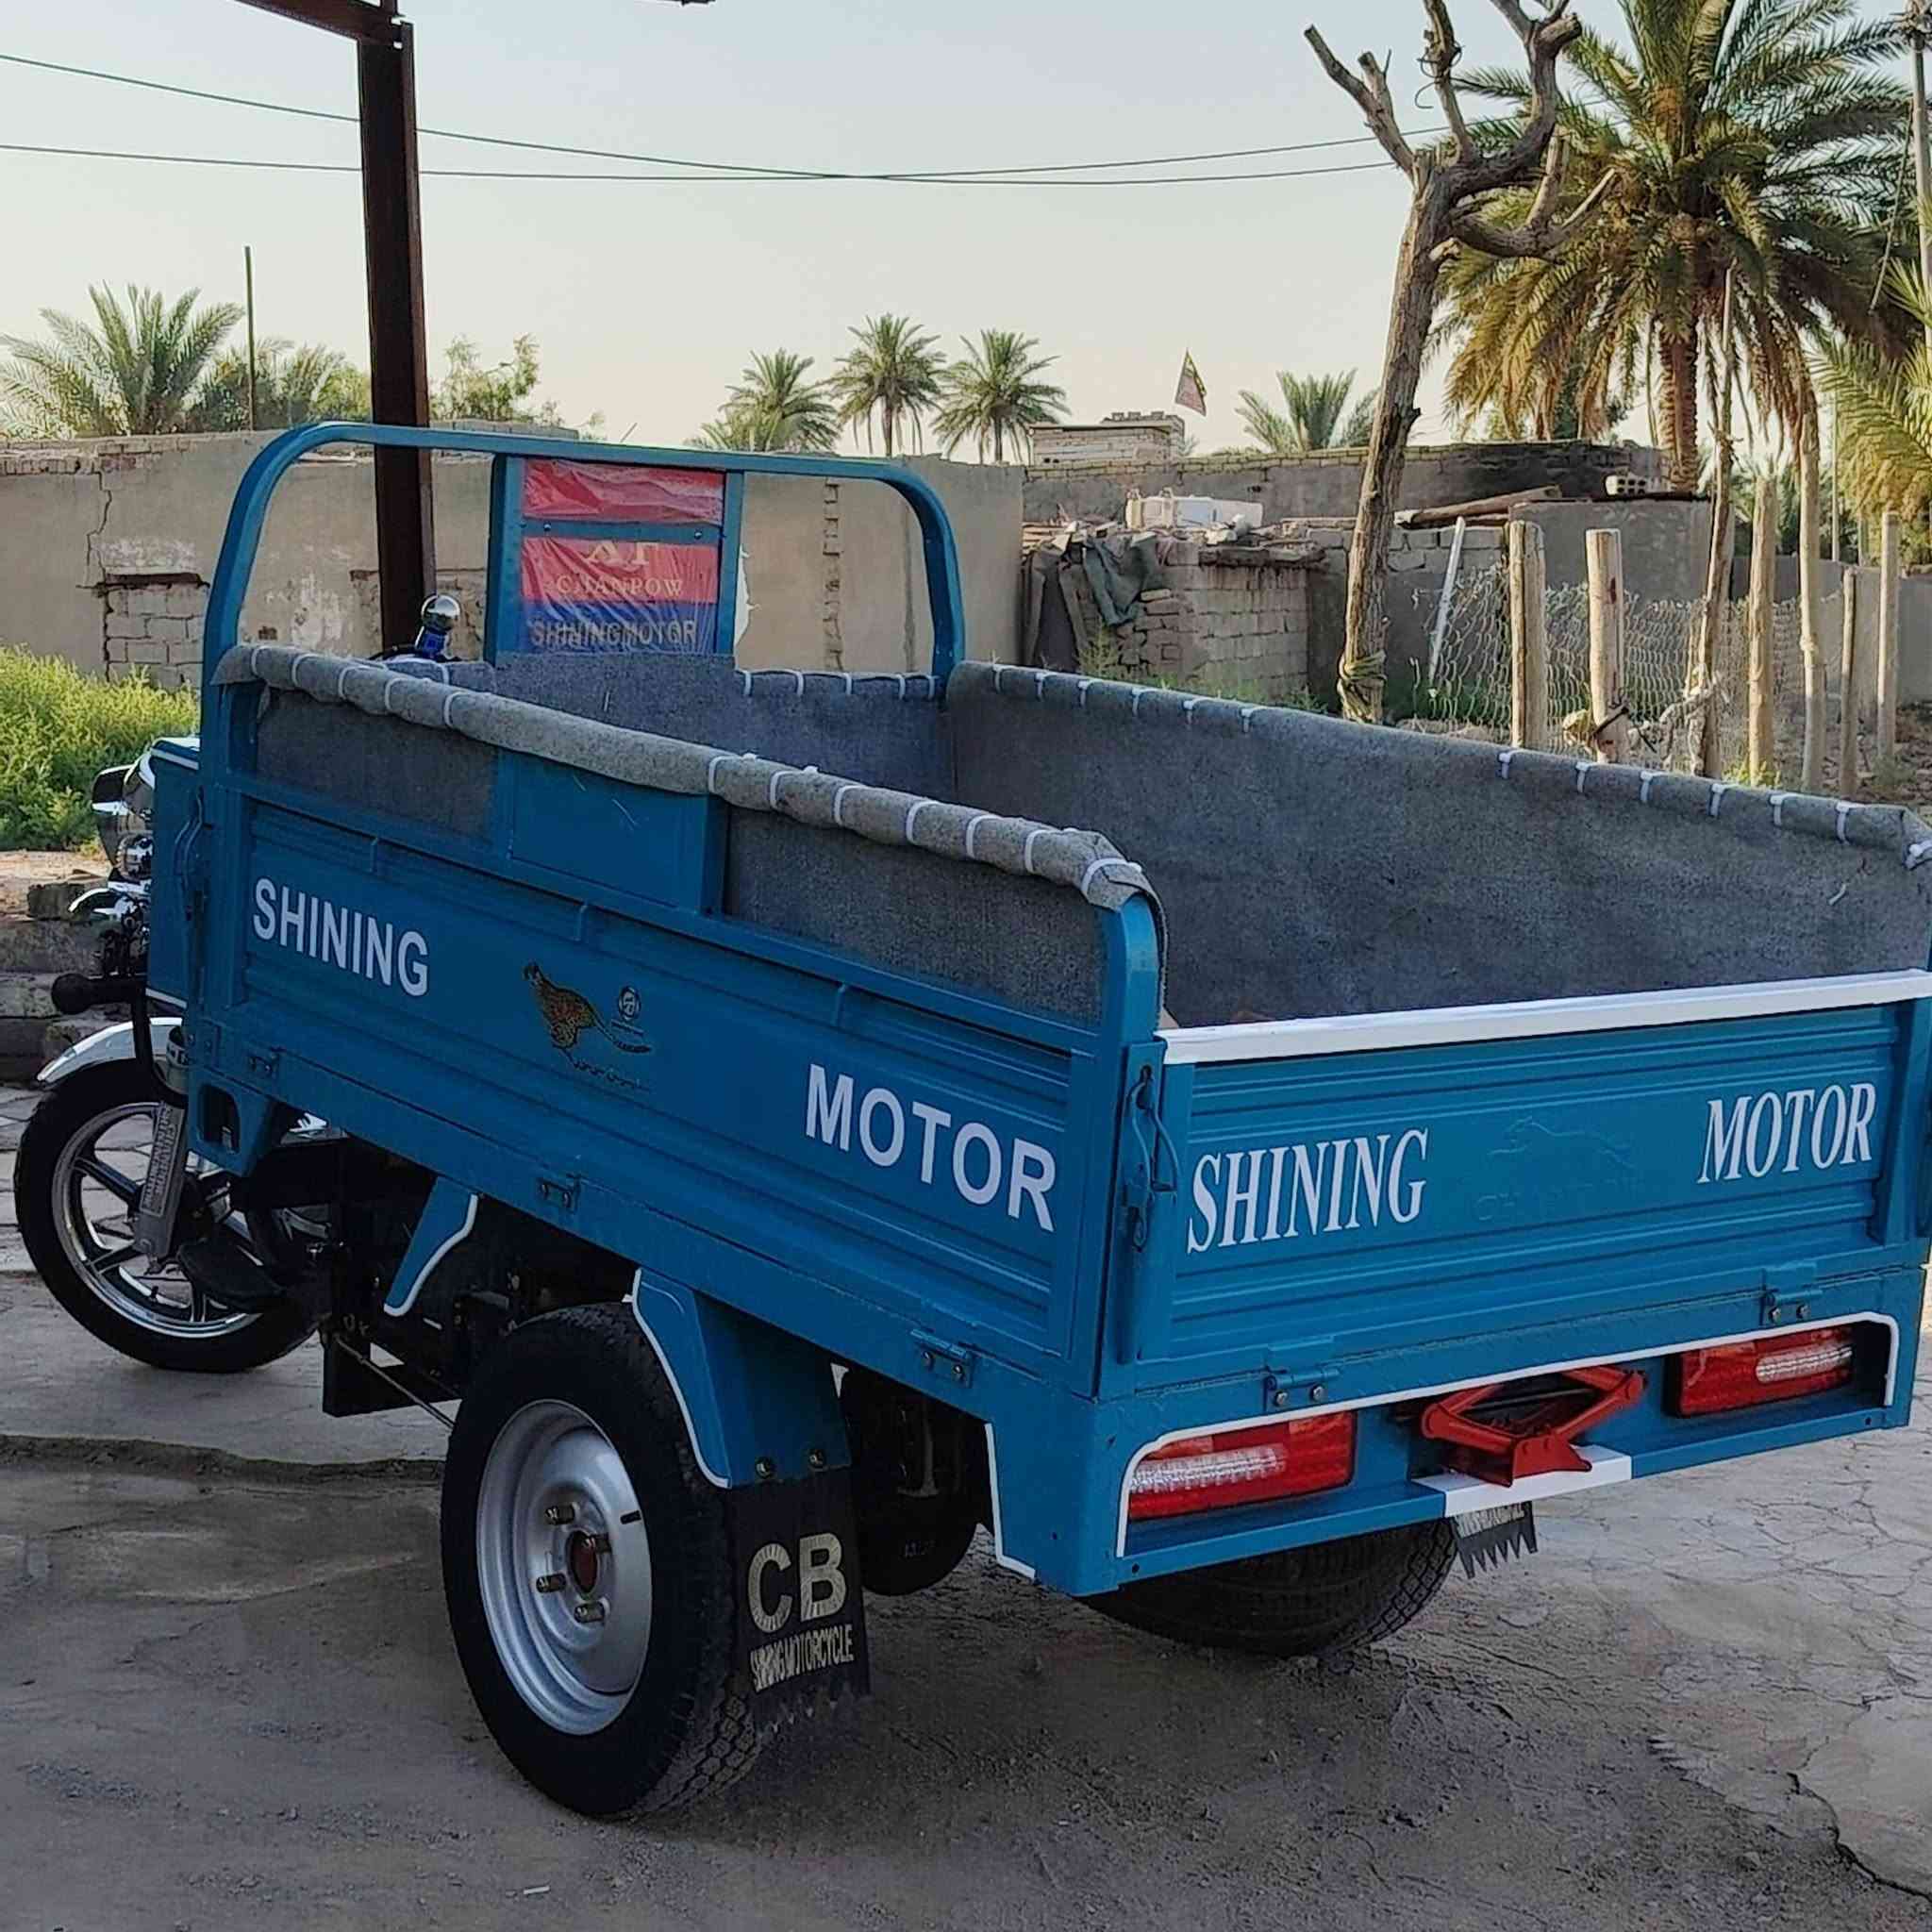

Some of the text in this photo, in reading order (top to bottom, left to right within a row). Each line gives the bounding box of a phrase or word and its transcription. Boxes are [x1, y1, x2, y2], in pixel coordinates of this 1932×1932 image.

[252, 877, 1057, 1233] SHINING MOTOR
[1187, 1127, 1428, 1254] SHINING
[1697, 1082, 1876, 1184] MOTOR
[748, 1532, 846, 1633] CB
